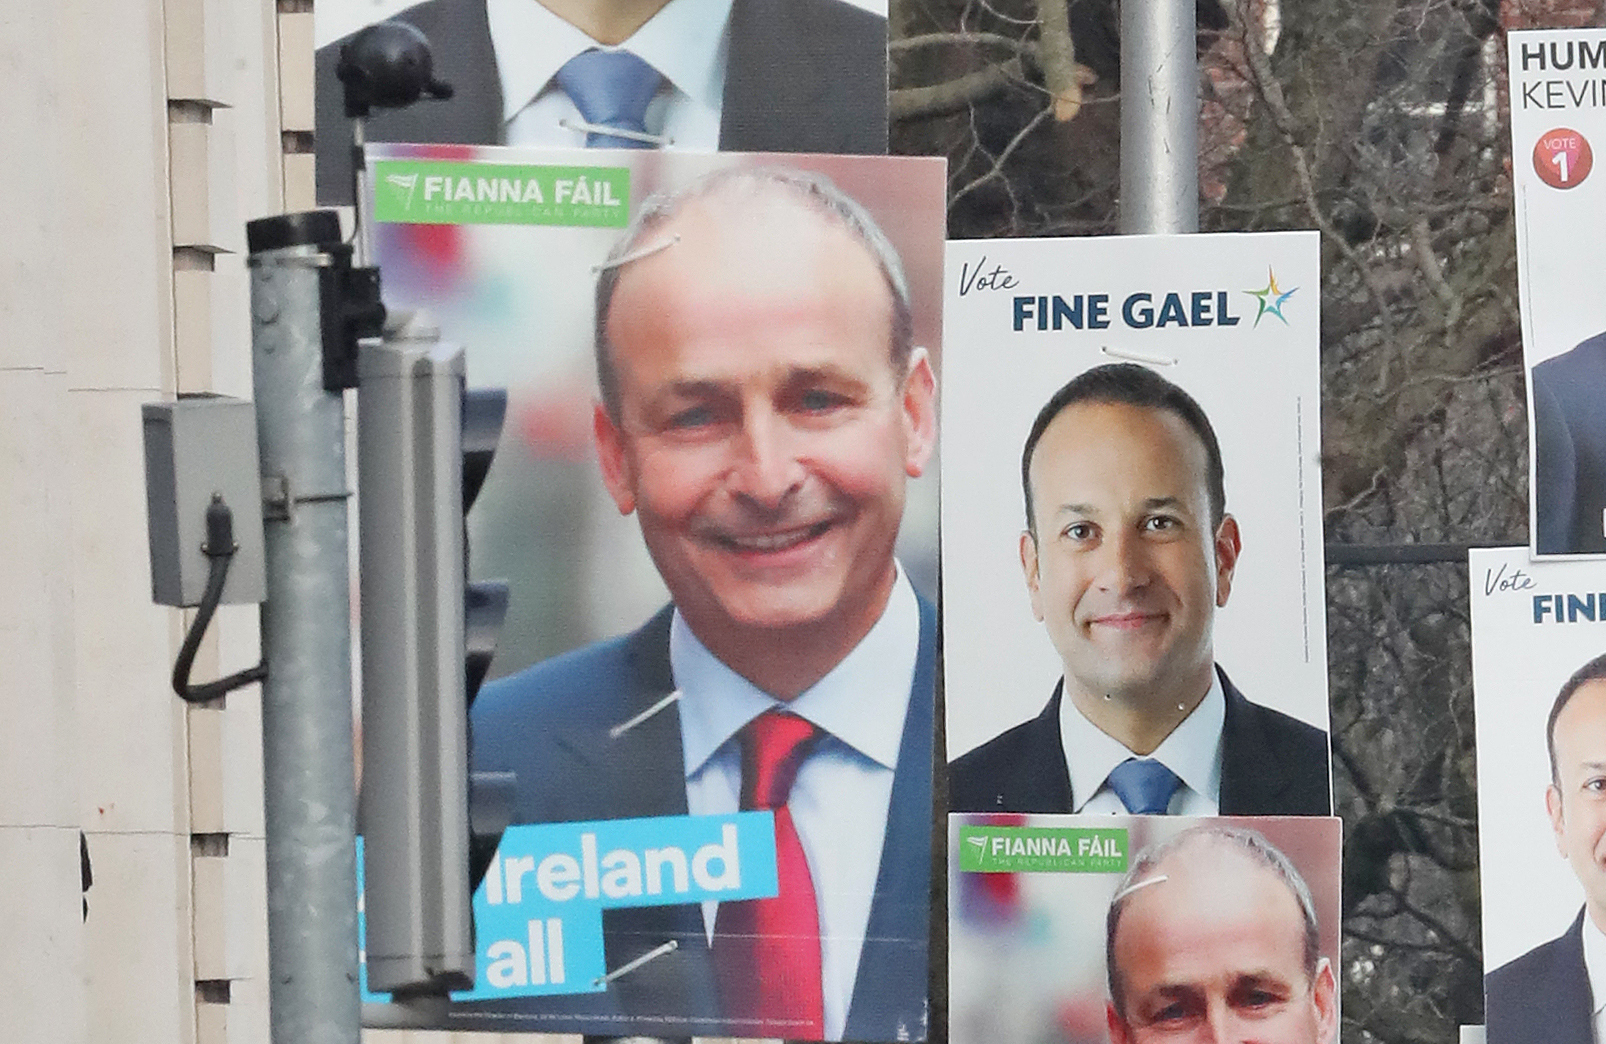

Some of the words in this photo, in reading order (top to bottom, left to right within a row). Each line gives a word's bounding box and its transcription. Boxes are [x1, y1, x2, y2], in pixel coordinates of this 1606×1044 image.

[1543, 138, 1578, 150] VOTE
[1551, 152, 1569, 182] 1
[423, 176, 544, 204] FIANNA
[554, 174, 621, 207] FÁIL
[959, 255, 1020, 297] Vote
[1012, 293, 1113, 332] FINE
[1121, 291, 1241, 330] GAEL
[1484, 563, 1538, 597] Vote
[991, 836, 1073, 858] FIANNA
[1078, 834, 1123, 858] FÁIL
[486, 823, 742, 906] Ireland
[485, 917, 567, 989] all
